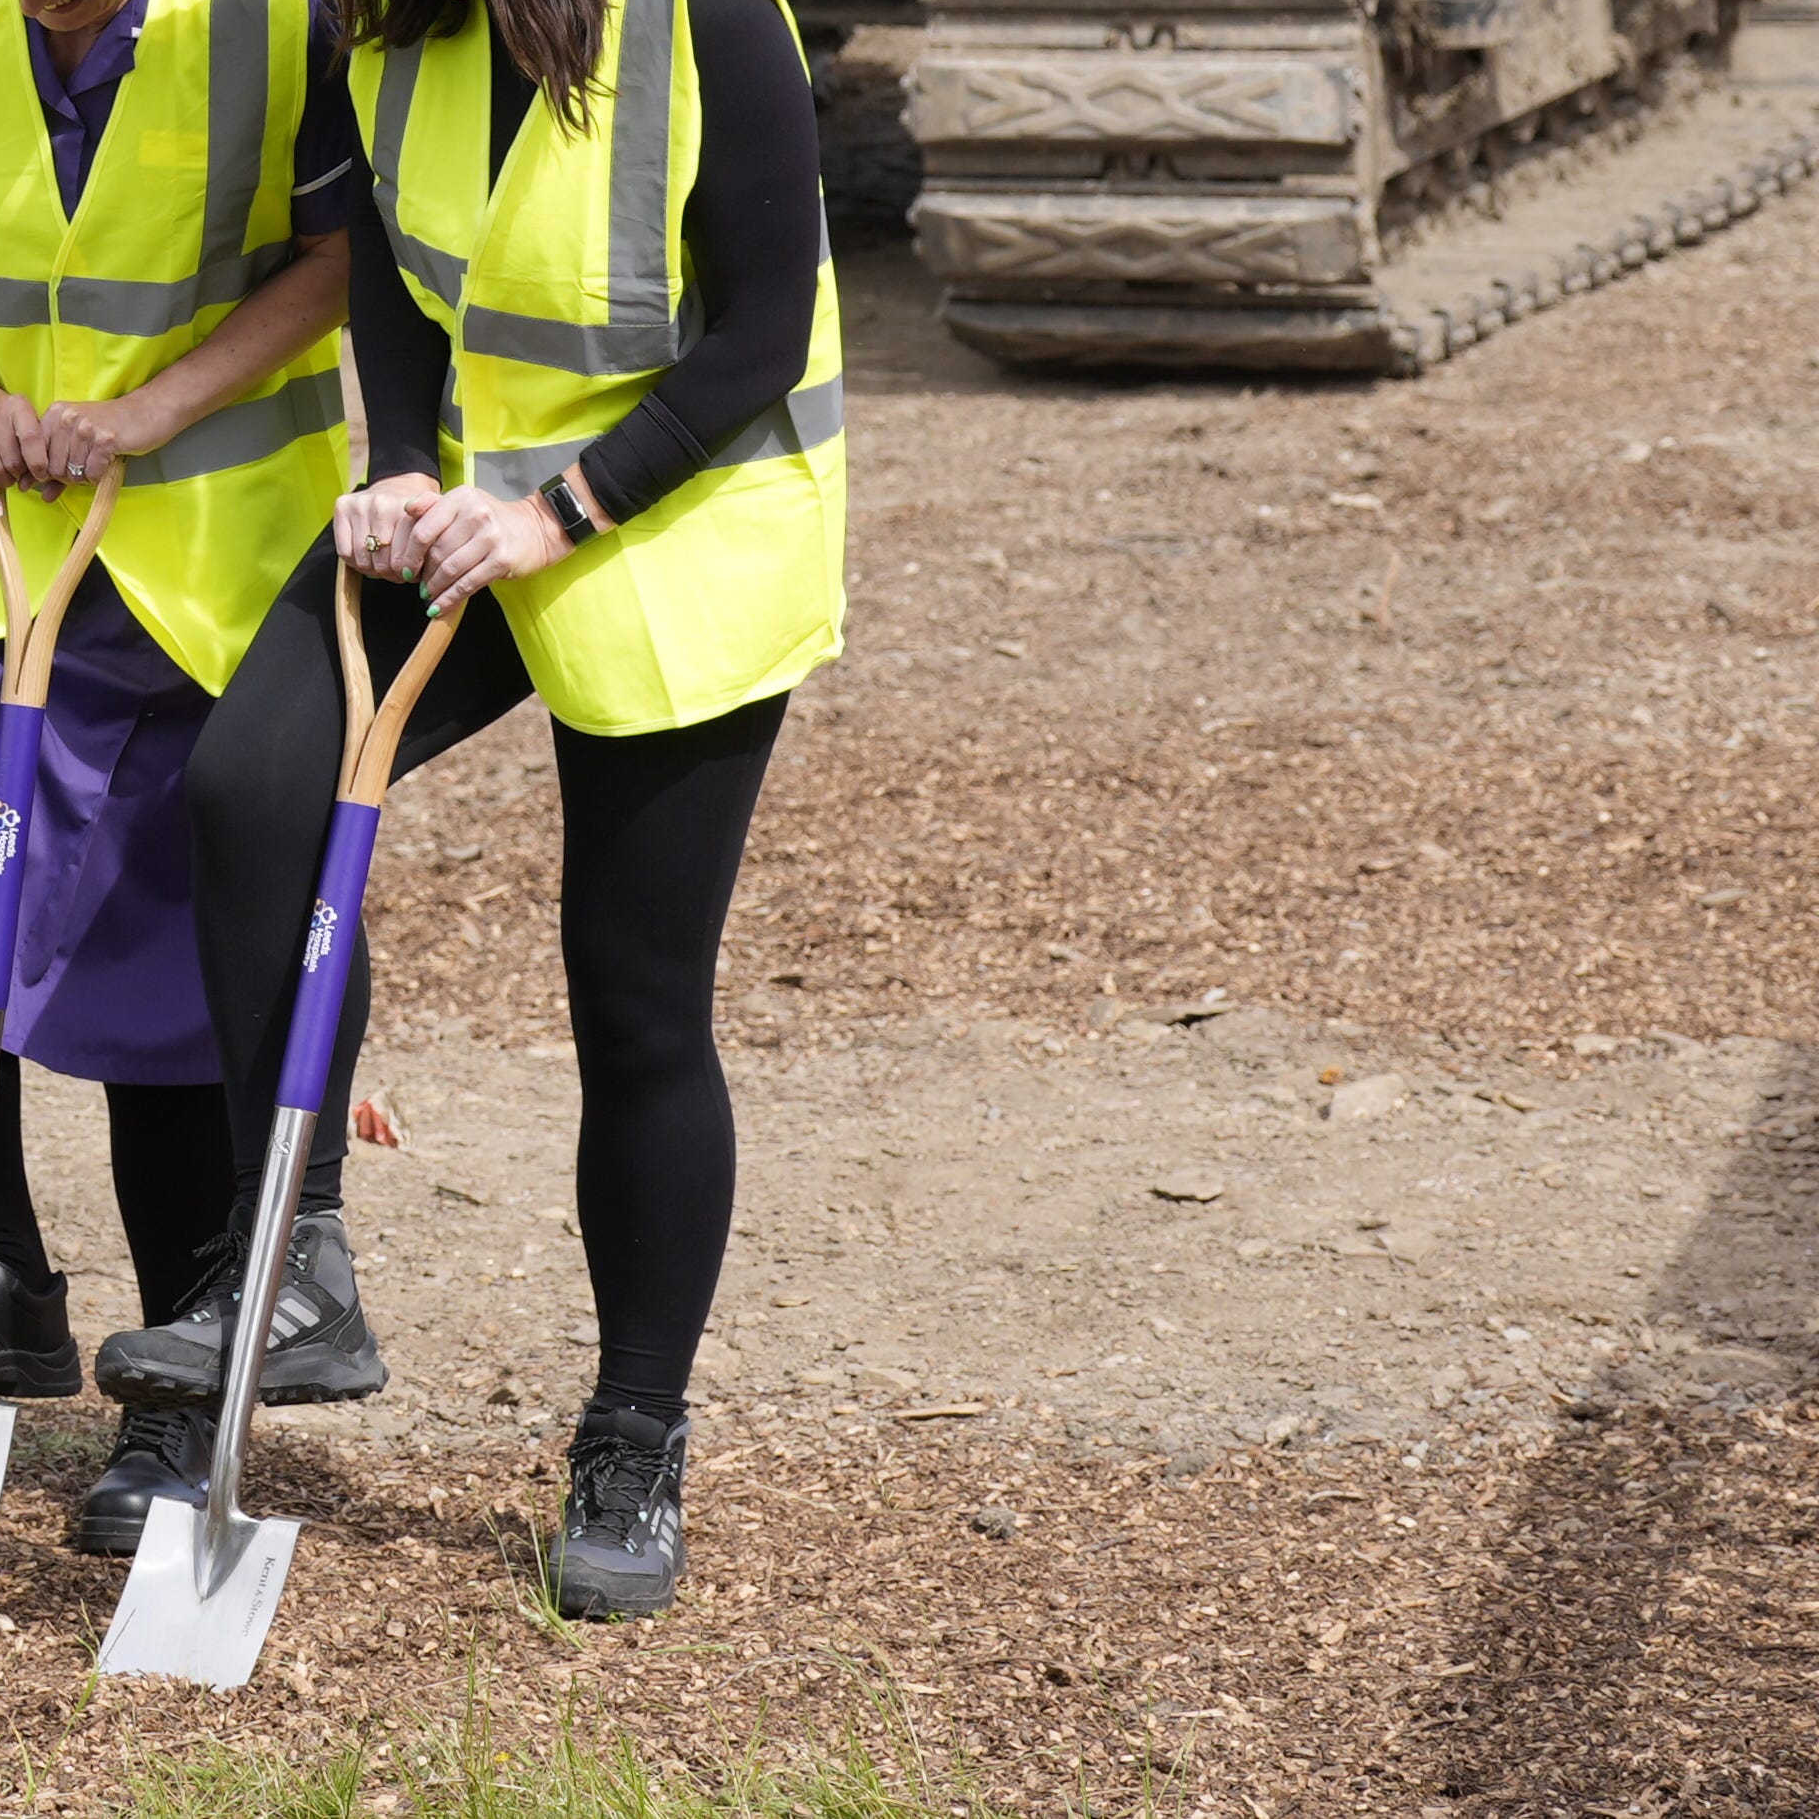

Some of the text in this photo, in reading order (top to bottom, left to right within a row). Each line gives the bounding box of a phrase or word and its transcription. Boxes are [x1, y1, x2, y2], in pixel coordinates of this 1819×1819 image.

[6, 828, 19, 858] Leeds
[302, 930, 316, 967] Charity
[307, 928, 324, 973] Hospitals
[320, 925, 335, 955] Leeds
[259, 1557, 275, 1588] Kent
[243, 1597, 263, 1637] Stowe
